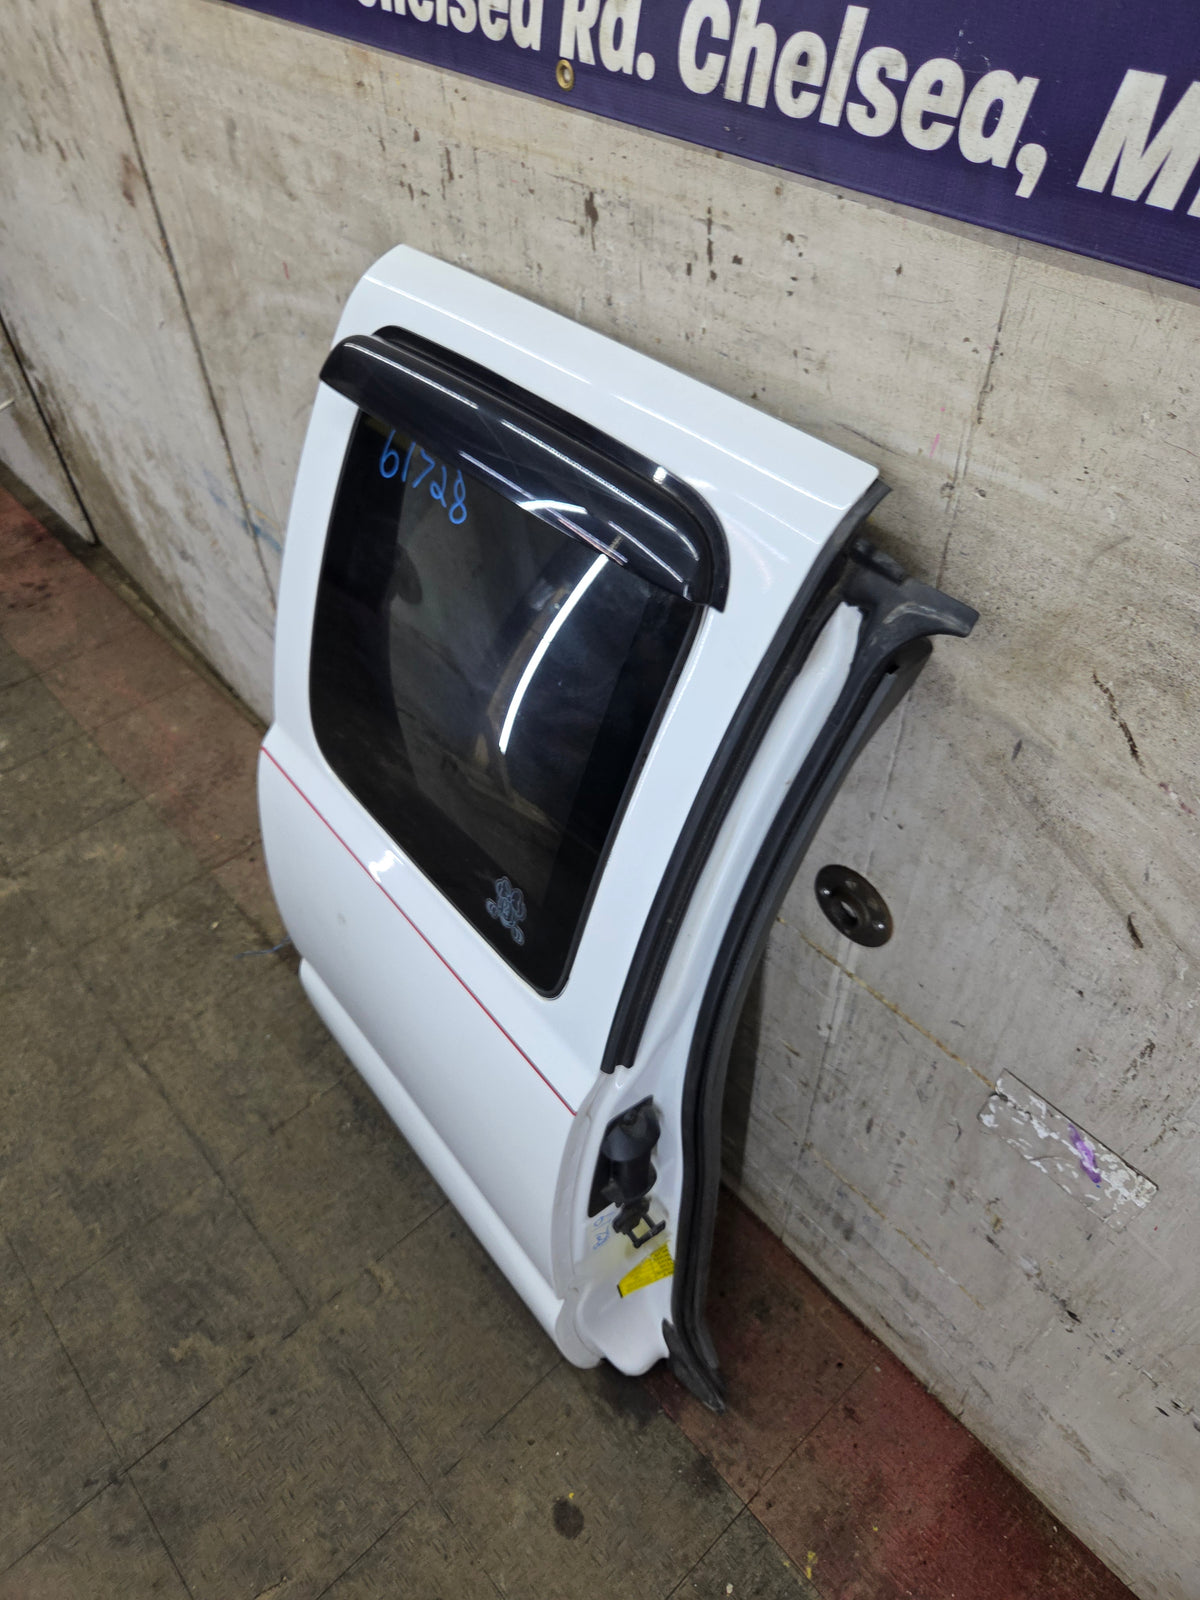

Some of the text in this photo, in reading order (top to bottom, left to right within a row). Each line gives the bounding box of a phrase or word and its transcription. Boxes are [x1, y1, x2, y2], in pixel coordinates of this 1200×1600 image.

[558, 0, 656, 80] Rd.
[677, 0, 1048, 199] Chelsea,
[1076, 68, 1200, 218] M
[379, 429, 468, 525] 61728
